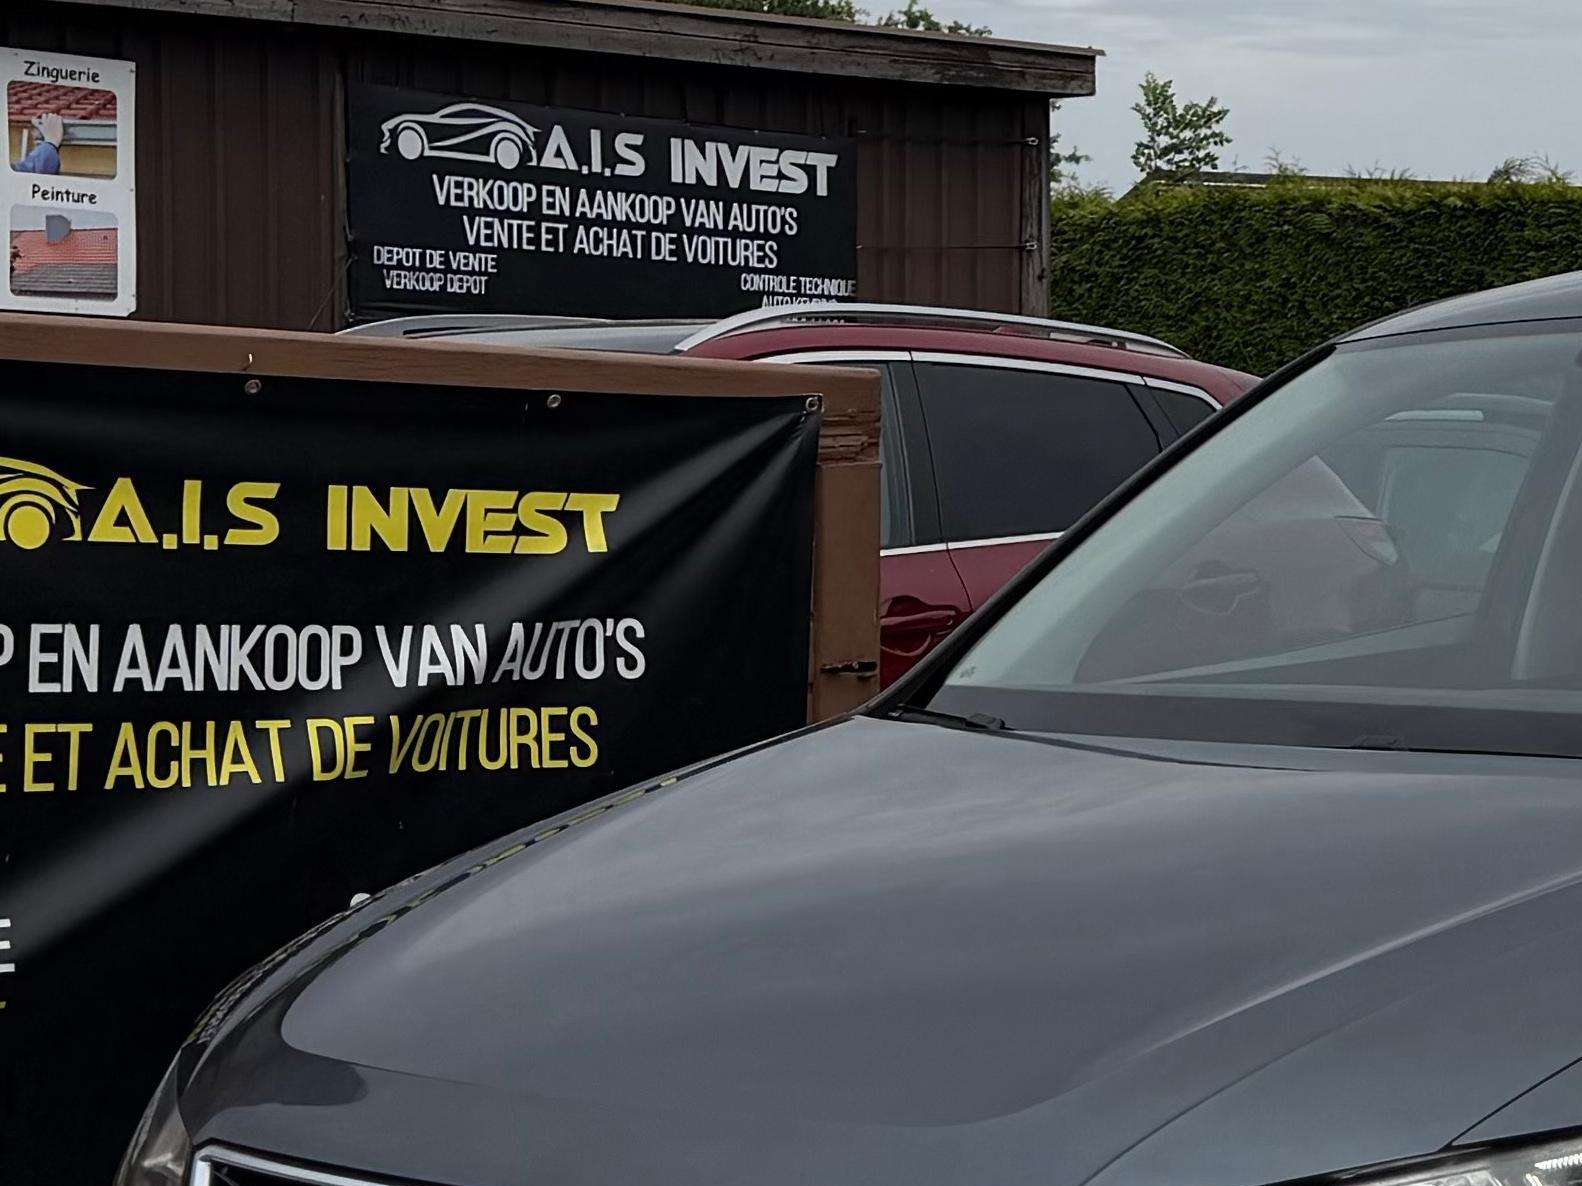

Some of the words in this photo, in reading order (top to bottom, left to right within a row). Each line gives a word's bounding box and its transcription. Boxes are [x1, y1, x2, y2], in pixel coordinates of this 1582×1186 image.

[24, 60, 100, 83] Zinguerie
[540, 125, 646, 176] A.I.S
[670, 137, 838, 197] INVEST
[31, 183, 97, 205] Peinture
[432, 173, 537, 213] VERKOOP
[541, 184, 570, 217] EN
[575, 188, 675, 225] AANKOOP
[680, 198, 724, 231] VAN
[728, 203, 798, 236] AUTO'S
[373, 245, 422, 268] DEPOT
[426, 249, 446, 270] DE
[449, 251, 498, 274] VENTE
[462, 215, 536, 251] VENTE
[540, 221, 568, 253] ET
[573, 225, 646, 260] ACHAT
[651, 231, 678, 262] DE
[682, 234, 778, 269] VOITURES
[383, 269, 444, 291] VERKOOP
[447, 274, 488, 295] DEPOT
[740, 272, 798, 294] CONTROLE
[799, 276, 857, 297] TECHNIQUE
[88, 477, 281, 551] A.I.S
[327, 485, 621, 554] INVEST
[28, 622, 98, 693] EN
[113, 623, 363, 693] AANKOOP
[375, 619, 488, 689] VAN
[492, 617, 646, 684] AUTO'S
[24, 722, 94, 792] ET
[104, 717, 292, 790] ACHAT
[306, 714, 375, 782] DE
[388, 705, 599, 774] VOITURES
